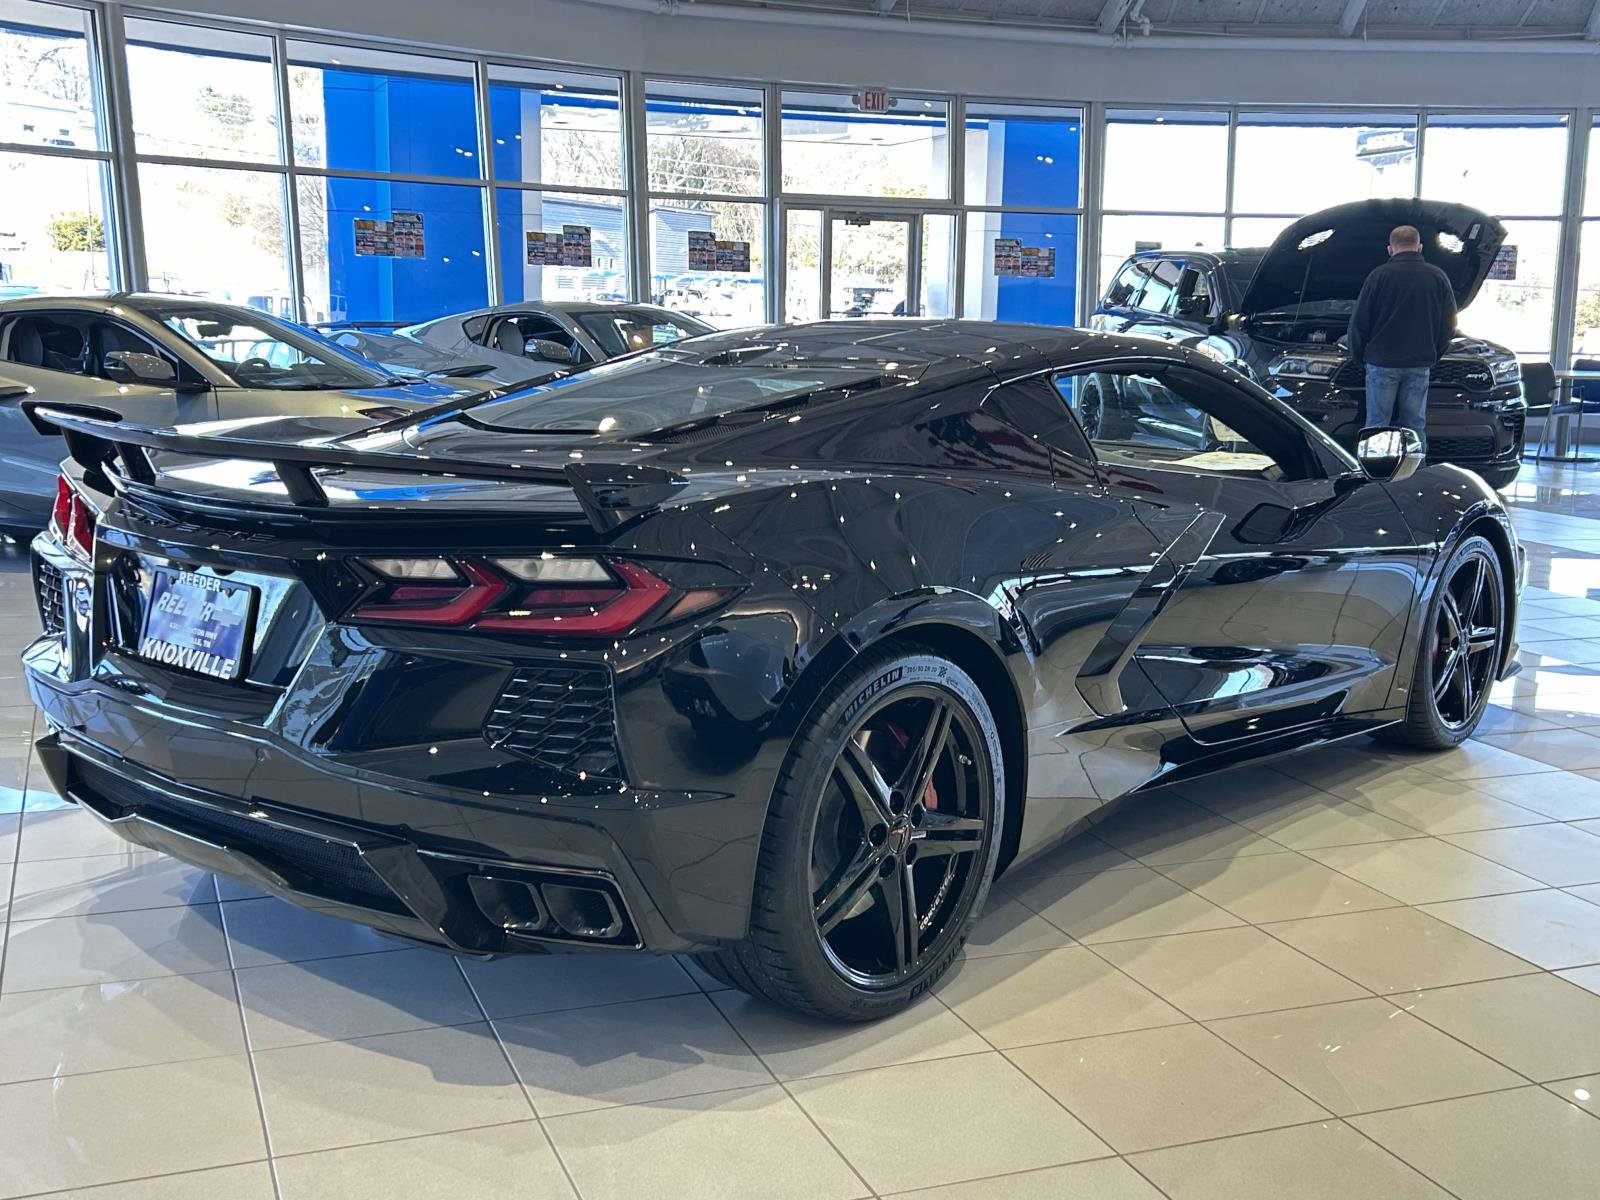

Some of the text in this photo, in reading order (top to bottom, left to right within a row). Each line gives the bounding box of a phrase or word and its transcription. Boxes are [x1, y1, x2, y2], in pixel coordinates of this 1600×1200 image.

[864, 92, 886, 110] EXIT
[178, 571, 221, 592] REEDER
[139, 637, 235, 680] KNOXVILLE
[844, 668, 901, 721] MICHELIN
